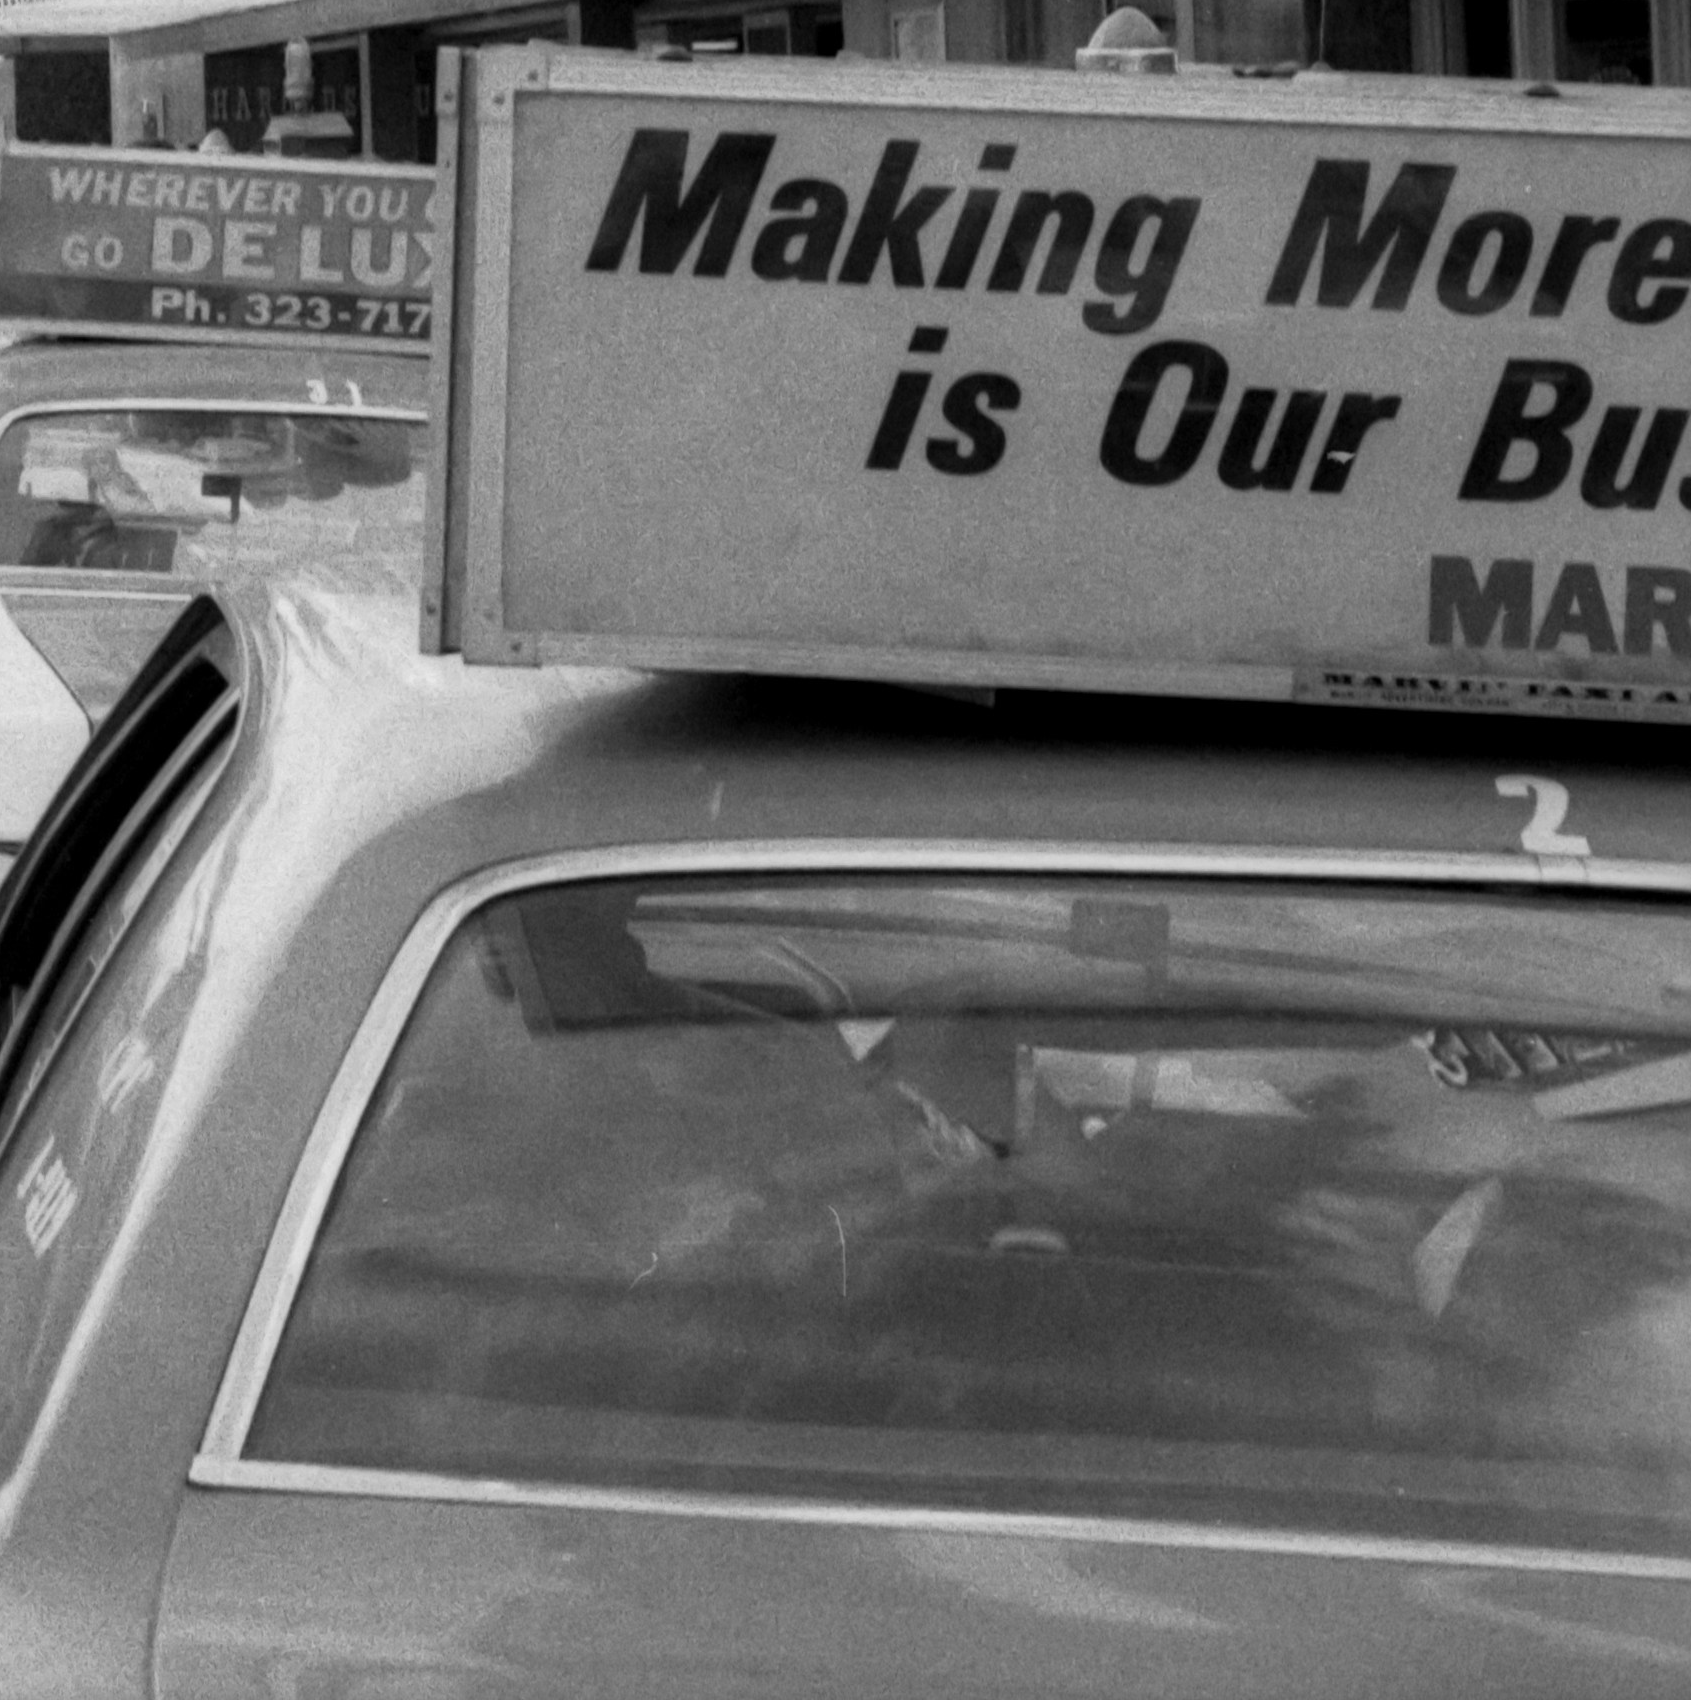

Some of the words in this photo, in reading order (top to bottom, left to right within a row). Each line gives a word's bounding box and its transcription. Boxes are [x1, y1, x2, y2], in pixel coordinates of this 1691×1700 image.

[50, 166, 302, 215] WHEREVER
[320, 184, 409, 222] YOU
[61, 234, 124, 271] GO
[152, 216, 278, 279] DE
[585, 129, 1202, 335] Making
[1266, 157, 1691, 326] More
[151, 287, 227, 322] Ph.
[866, 328, 1022, 476] is
[1099, 340, 1403, 496] Our
[1496, 775, 1591, 857] 2
